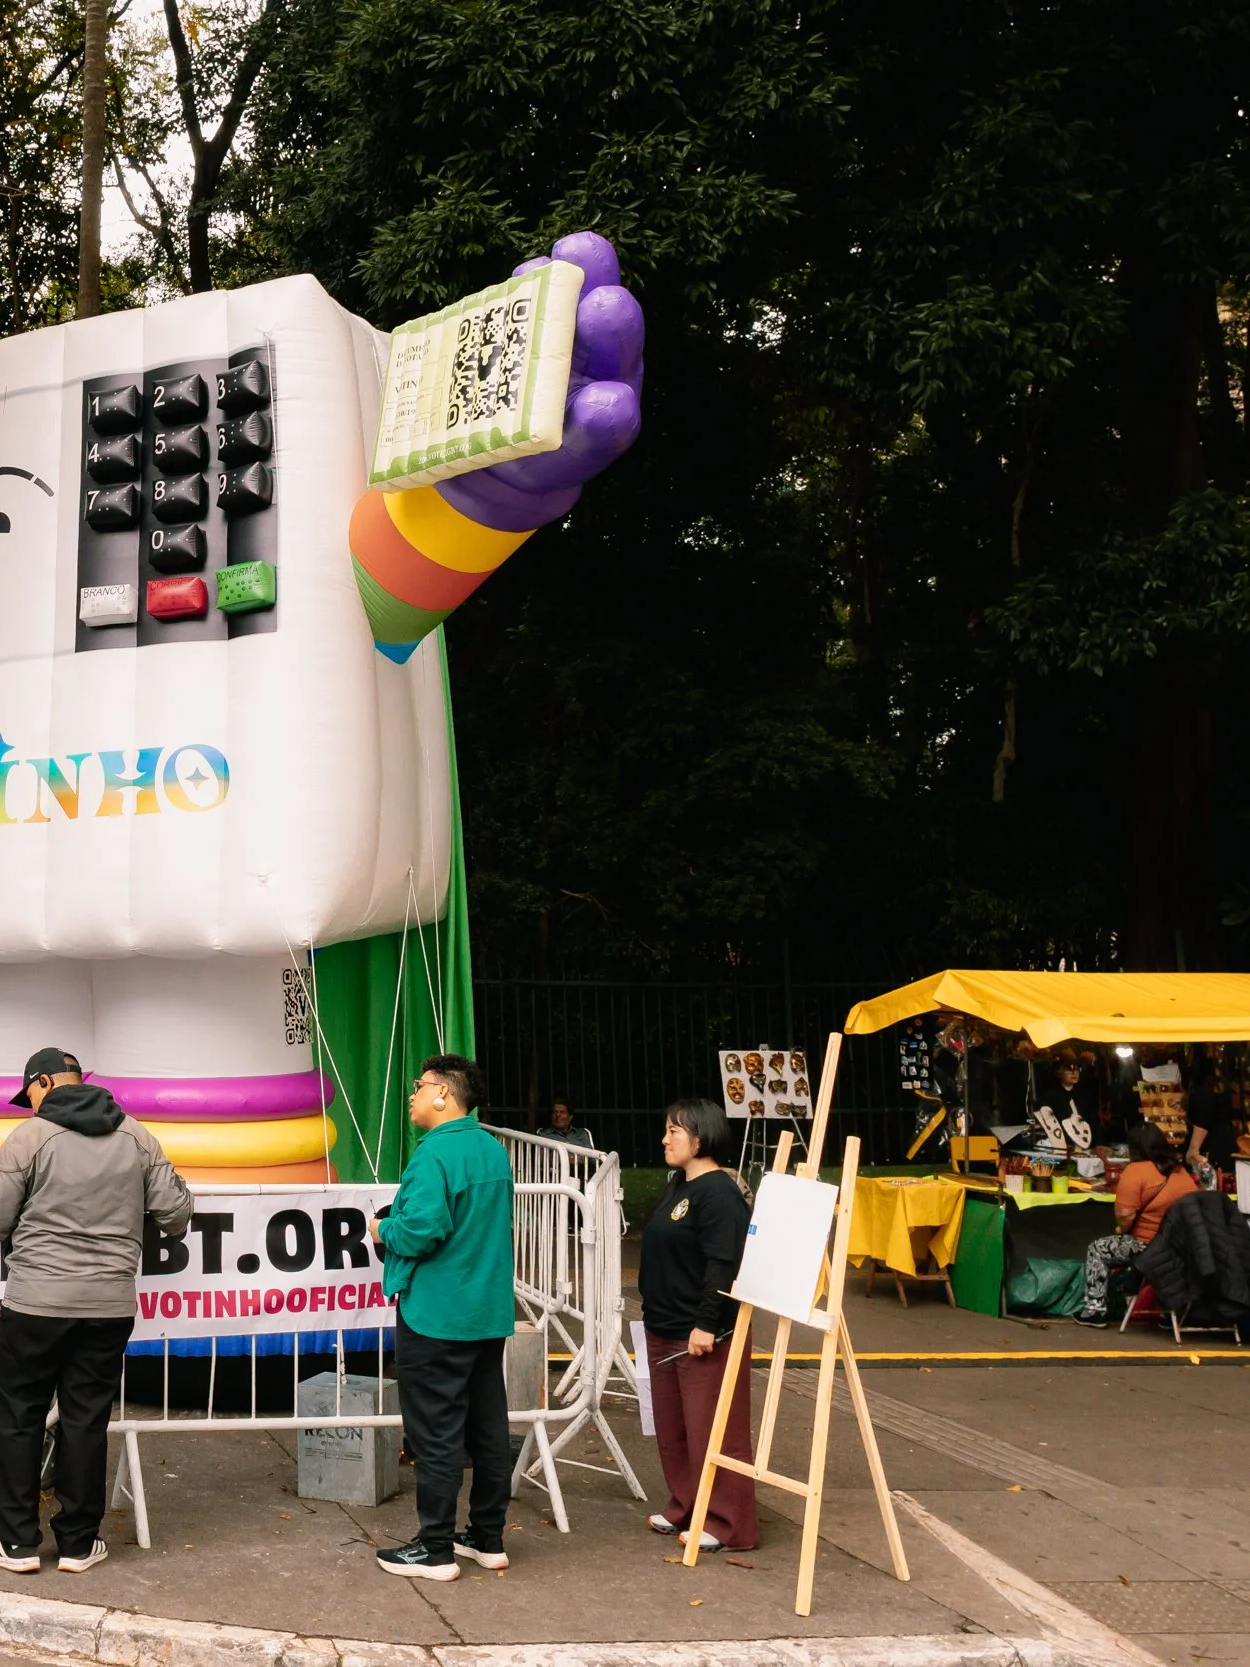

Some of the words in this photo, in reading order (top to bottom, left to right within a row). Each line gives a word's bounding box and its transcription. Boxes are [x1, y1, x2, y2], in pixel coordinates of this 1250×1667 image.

[153, 386, 166, 407] 2
[217, 378, 226, 400] 3
[91, 396, 100, 416] 1
[154, 433, 166, 455] 5
[218, 428, 226, 449] 6
[88, 443, 100, 462] 4
[154, 481, 166, 501] 8
[218, 474, 227, 495] 9
[87, 490, 100, 510] 7
[151, 530, 164, 550] 0
[83, 585, 126, 599] BRANCO
[135, 1281, 398, 1320] VOTINHOOFICIA
